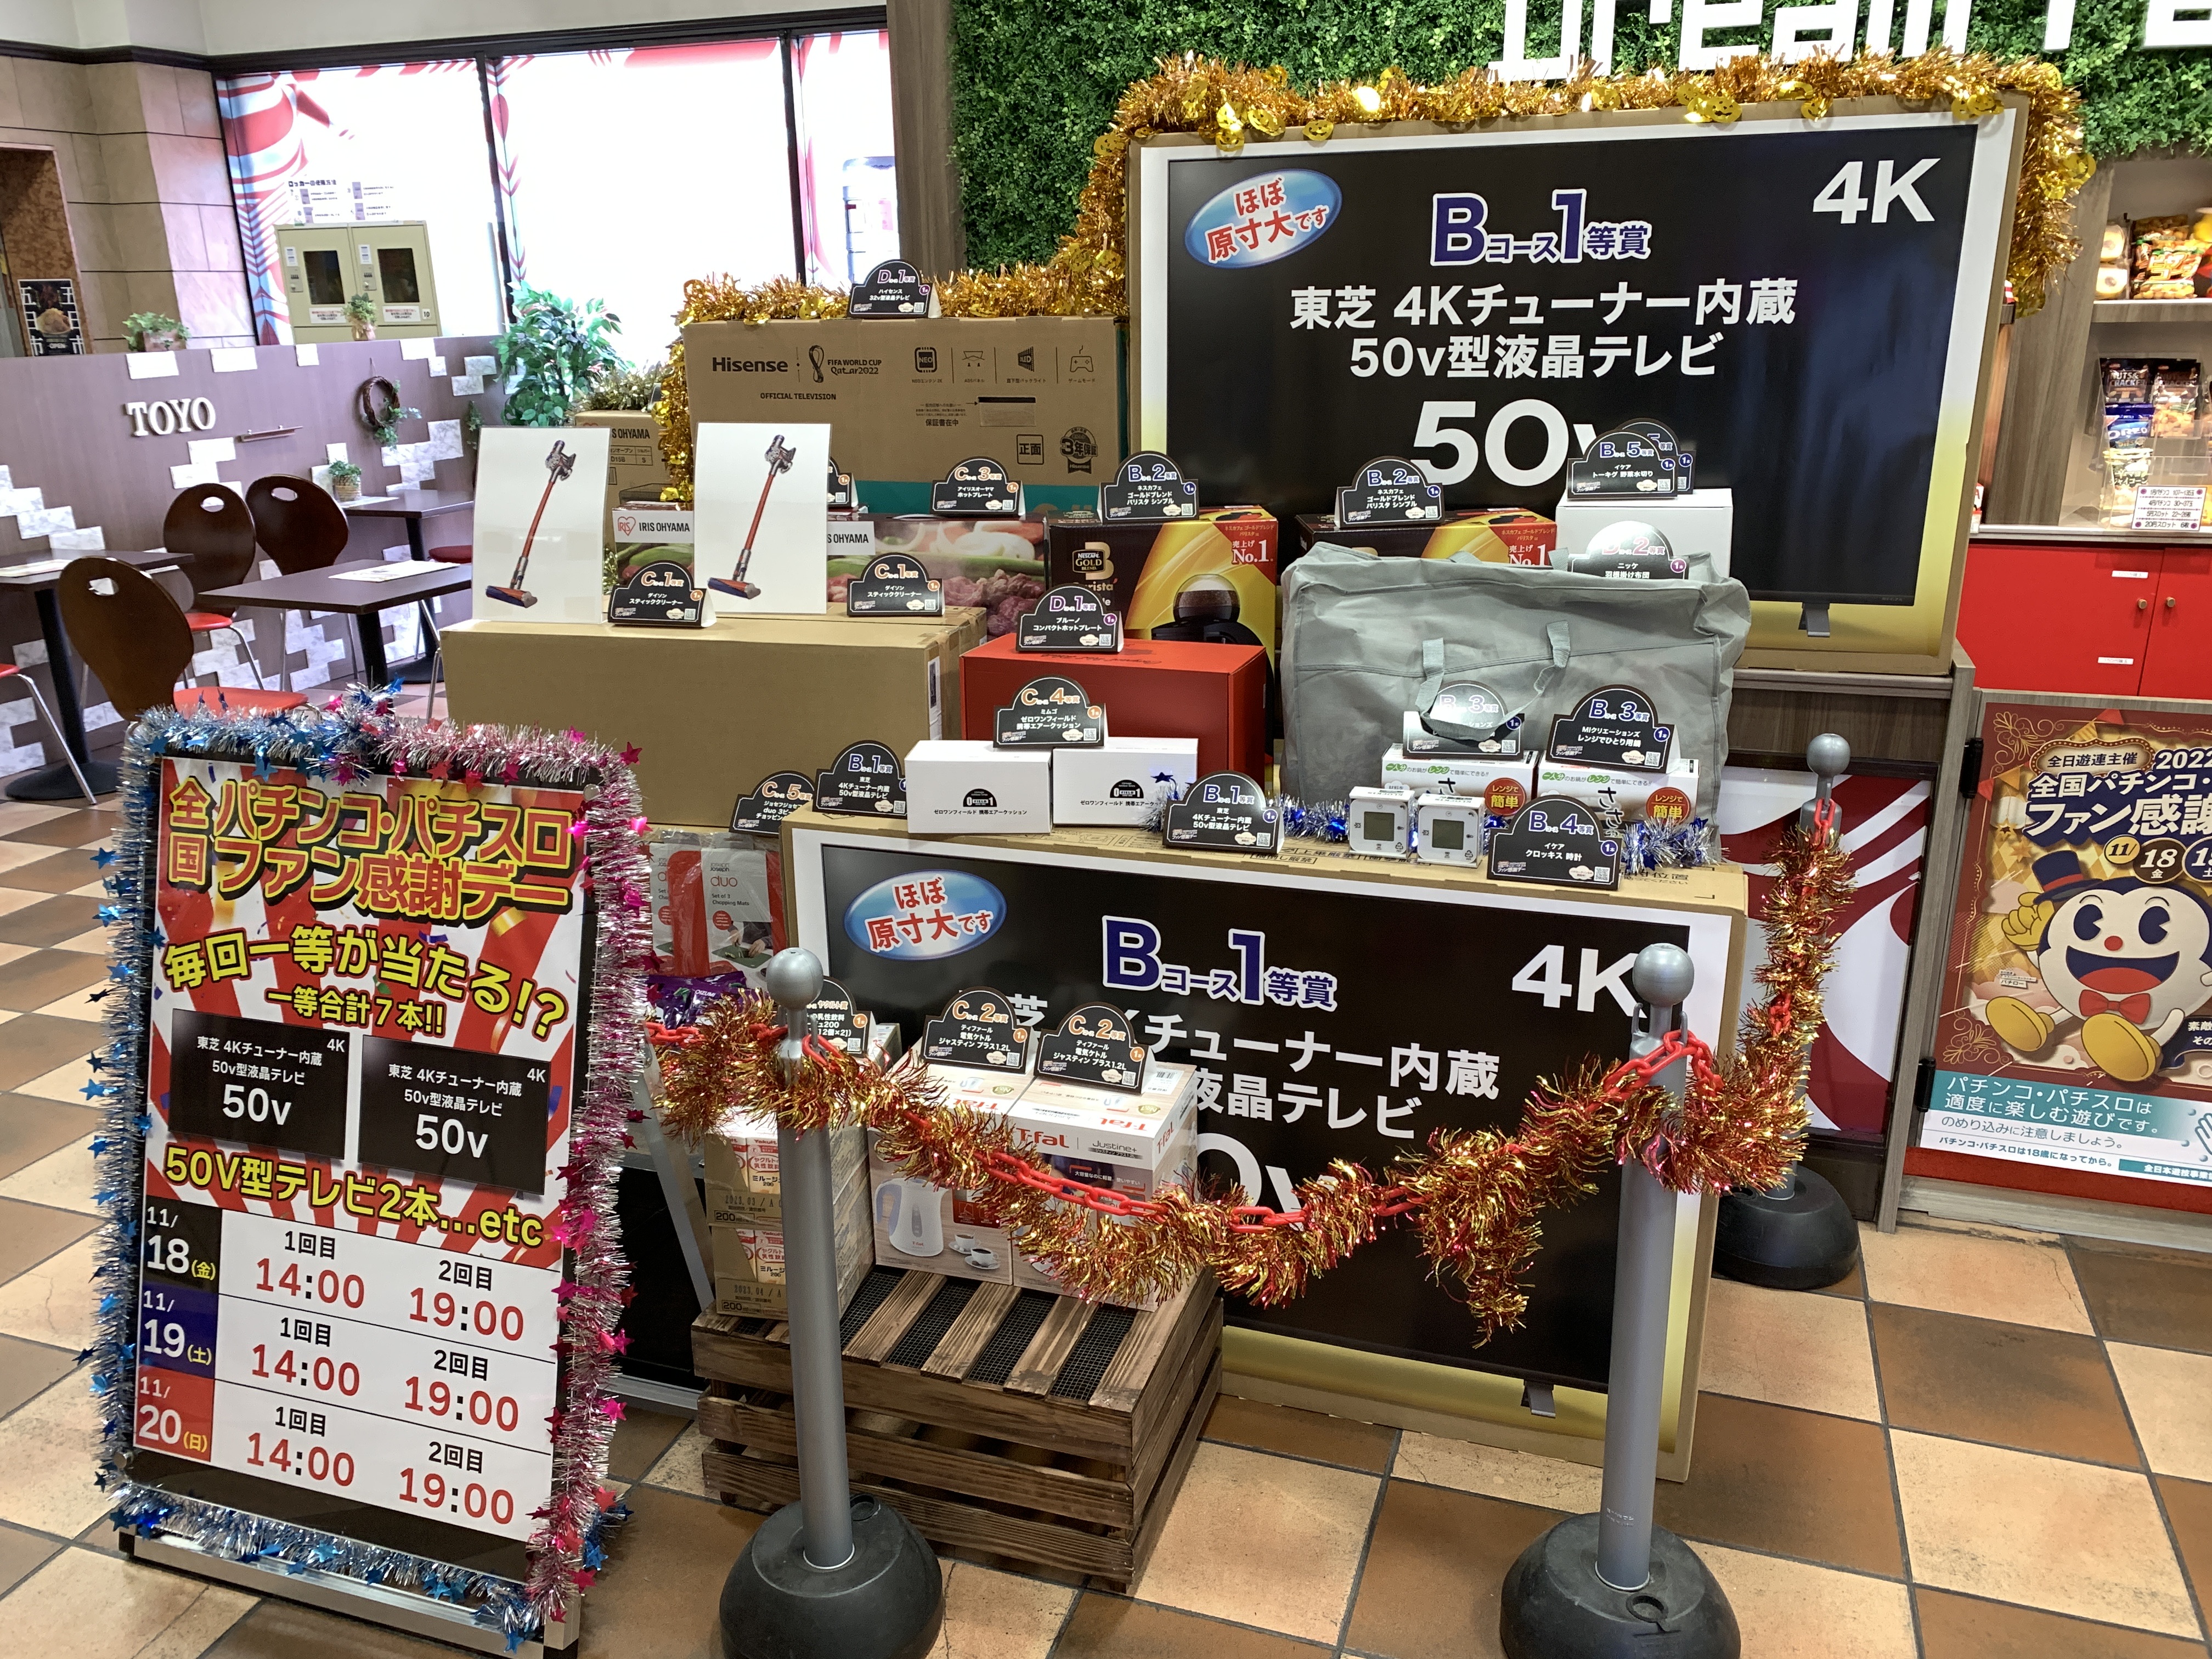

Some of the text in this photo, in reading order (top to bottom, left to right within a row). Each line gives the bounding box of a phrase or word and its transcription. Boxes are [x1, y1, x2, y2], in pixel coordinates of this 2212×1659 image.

[1234, 177, 1285, 214] ほぼ
[1812, 157, 1942, 224] 4K
[1207, 206, 1330, 263] 原寸大です
[1290, 276, 1798, 330] 東芝 4Kチューナー内蔵
[712, 357, 788, 373] Hisense
[1350, 331, 1724, 379] 50v型液晶テレビ
[127, 397, 216, 438] TOYO
[926, 419, 959, 427] 保証書在中
[618, 428, 650, 439] OHYAMA
[2107, 427, 2148, 439] OREO
[1019, 443, 1041, 456] 正面
[1367, 494, 1415, 503] ゴールドブレンド
[639, 522, 690, 533] IRIS OHYAMA
[833, 533, 869, 544] OHYAMA
[1232, 540, 1255, 548] 売上げ
[1232, 539, 1269, 563] No.1
[1577, 735, 1641, 748] レンジでひとり用鍋
[1582, 726, 1641, 738] MIクリエーションズ
[2047, 752, 2138, 769] 全日遊連主催
[838, 782, 890, 793] 4Kチューナー内蔵
[839, 790, 888, 799] 50v型液晶テレビ
[1491, 795, 1519, 809] 簡単
[214, 782, 576, 872] パチンコ・パチスロ
[1192, 814, 1252, 825] 4Kチューナー内蔵
[1193, 821, 1250, 831] 50v型液晶テレビ
[1525, 849, 1583, 861] クロッキス 時計
[2140, 848, 2178, 868] 18
[214, 836, 572, 922] ファン感謝デー
[710, 876, 738, 887] duo
[2150, 869, 2164, 879] 金
[893, 876, 946, 911] ほぼ
[865, 908, 994, 953] 原寸大です
[695, 989, 716, 997] OIZUMI
[960, 1032, 991, 1041] 電気ケトル
[961, 1025, 994, 1034] ティファール
[196, 1035, 323, 1068] 東芝 4Kチューナー内蔵
[326, 1039, 346, 1053] 4K
[939, 1037, 1011, 1052] ジャスティン プラス1.2L
[1075, 1048, 1108, 1059] 電気ケトル
[1076, 1040, 1110, 1051] ティファール
[1125, 1007, 1501, 1100] チューナー内蔵
[1053, 1052, 1127, 1070] ジャスティン プラス1.2L
[212, 1060, 306, 1086] 50v型液晶テレビ
[388, 1063, 522, 1098] 東芝 4Kチューナー内蔵
[527, 1068, 546, 1084] 4K
[222, 1083, 292, 1126] 50v
[404, 1088, 503, 1118] 50v型液晶テレビ
[1194, 1066, 1423, 1140] 液晶テレビ
[1946, 1076, 2153, 1115] パチンコ・パチスロは
[1944, 1092, 2158, 1134] 適度に楽しむ遊びです。
[415, 1114, 489, 1160] 50v
[1016, 1127, 1137, 1153] T-fal Justine+
[1942, 1116, 2123, 1150] のめり込みに注意しましょう。
[146, 1207, 493, 1291] 11/ 1回目 2回目
[256, 1257, 365, 1309] 14:00
[410, 1286, 524, 1342] 19:00
[143, 1291, 489, 1381] 11/ 1回目 2回目
[251, 1344, 360, 1398] 14:00
[404, 1376, 518, 1432] 19:00
[139, 1376, 483, 1474] 11/ 1回目 2回目
[246, 1432, 354, 1487] 14:00
[399, 1468, 514, 1525] 19:00
